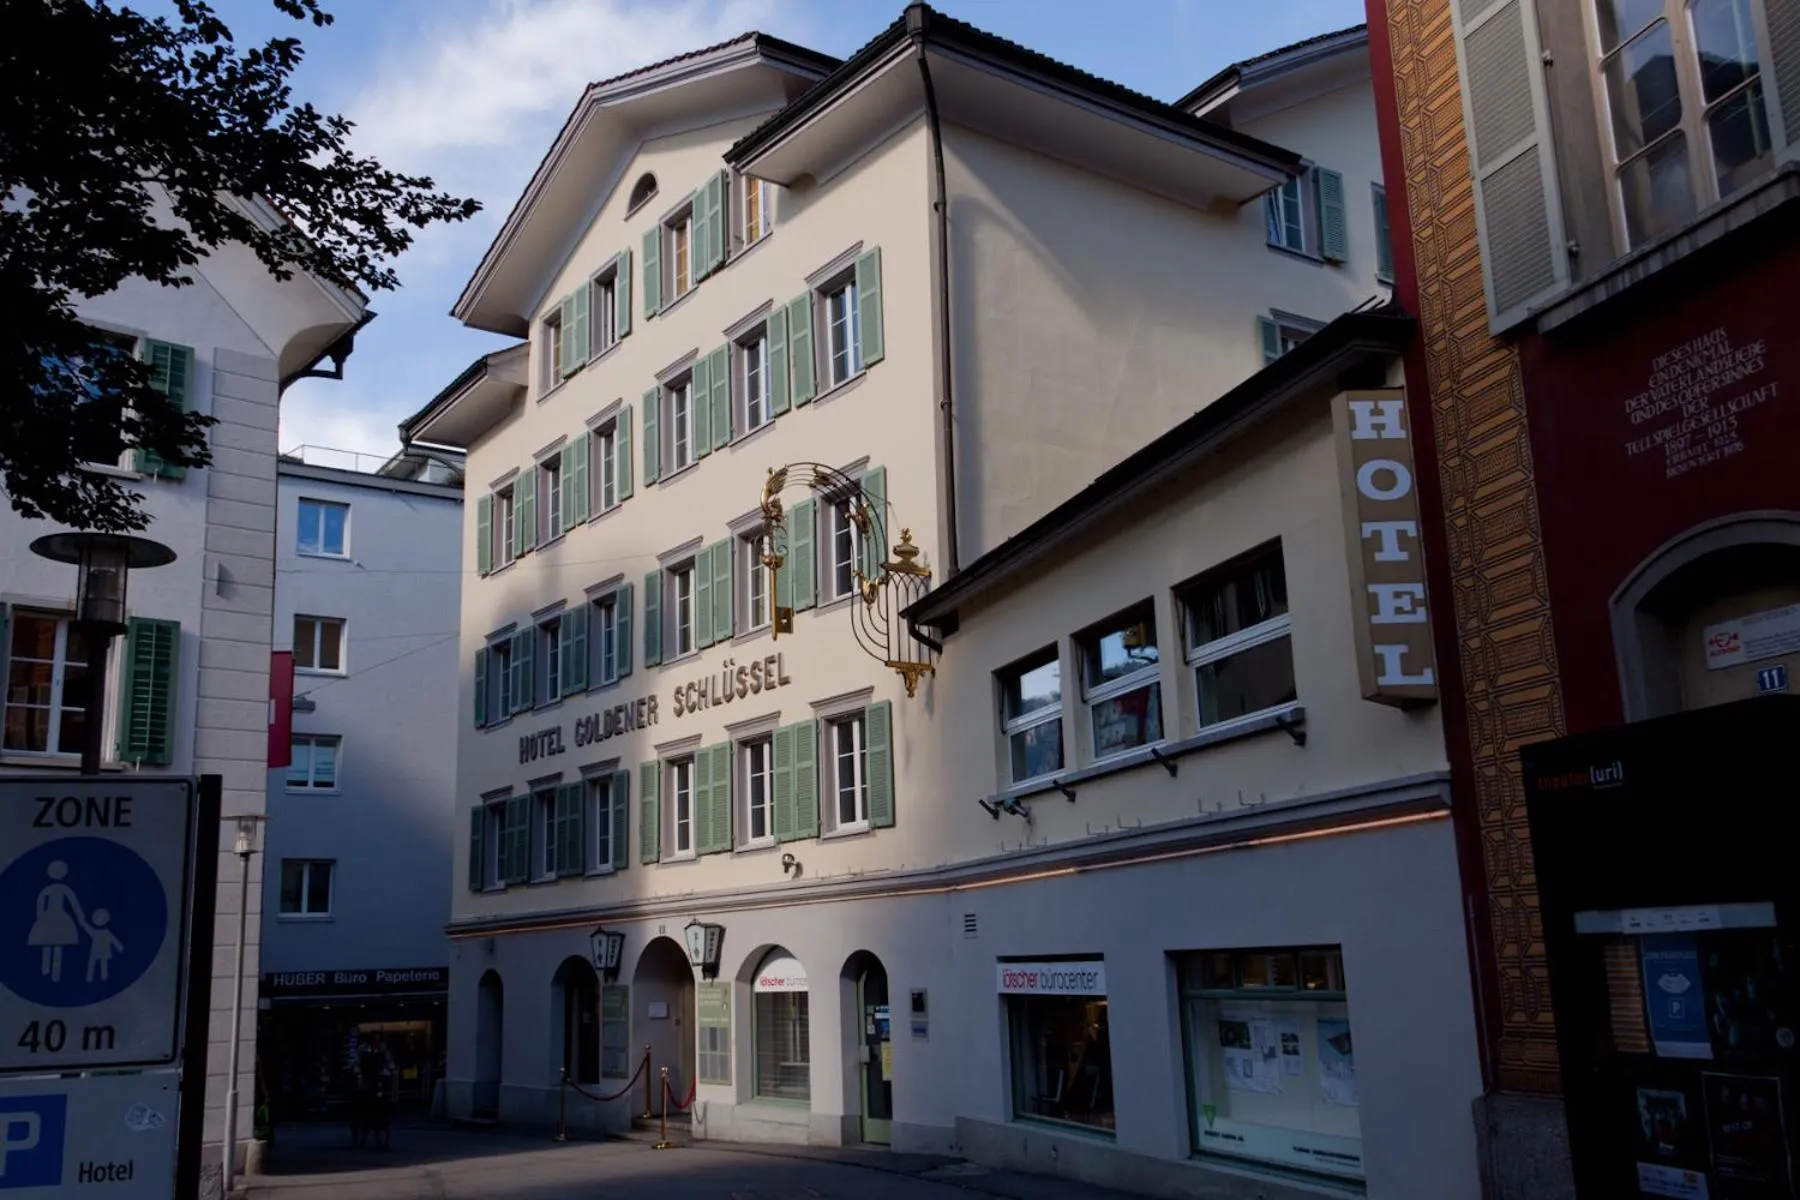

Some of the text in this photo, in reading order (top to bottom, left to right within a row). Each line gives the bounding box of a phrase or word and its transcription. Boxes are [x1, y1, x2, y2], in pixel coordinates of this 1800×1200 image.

[1348, 400, 1435, 687] HOTEL
[1763, 669, 1780, 690] 11
[519, 652, 791, 765] HOTEL GOLDENER SCHLÜSSEL
[32, 796, 132, 828] ZONE
[273, 969, 440, 988] HUBER Büro Papeterie
[17, 1020, 116, 1053] 40 m
[0, 1111, 41, 1177] P
[78, 1159, 134, 1184] Hotel
